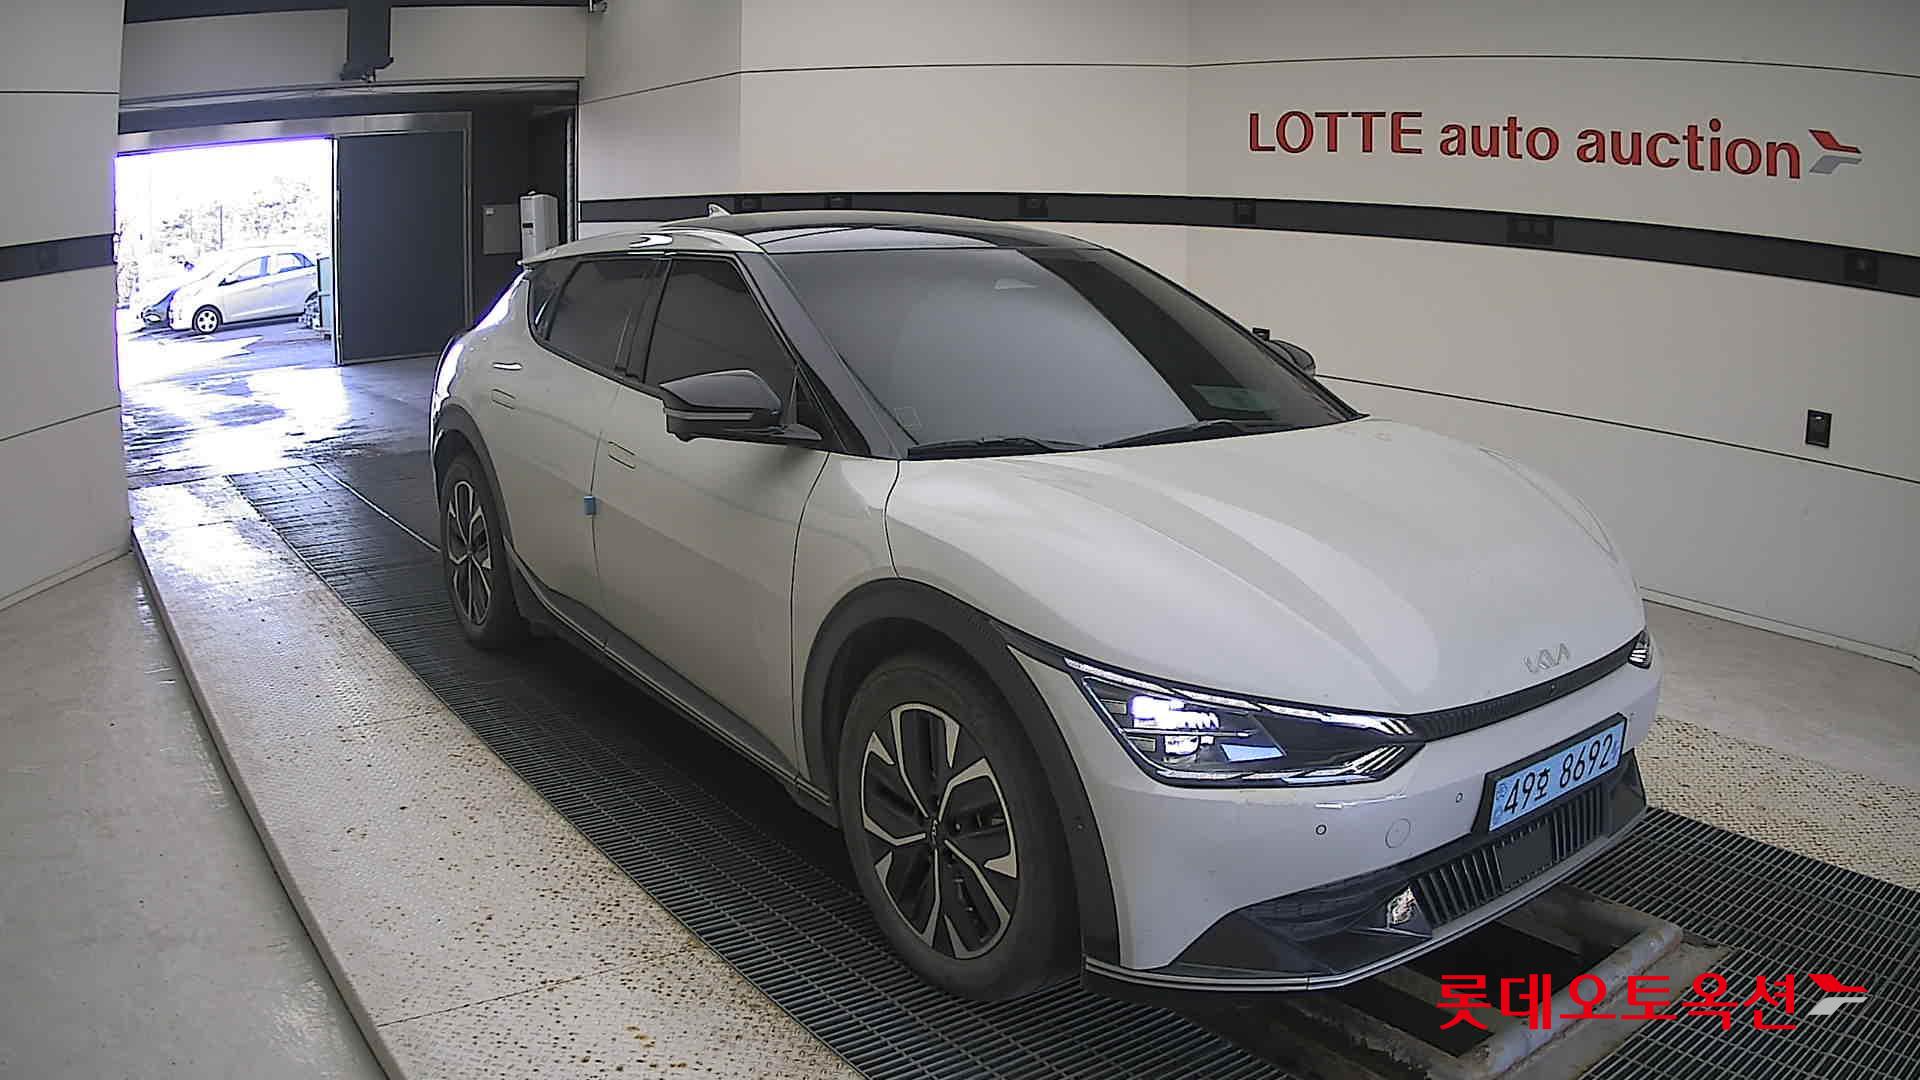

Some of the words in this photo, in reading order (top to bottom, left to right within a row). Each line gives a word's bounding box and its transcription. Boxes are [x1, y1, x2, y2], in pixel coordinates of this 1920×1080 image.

[1248, 111, 1424, 155] LOTTE
[1439, 116, 1560, 161] auto
[1576, 118, 1801, 179] auction
[1504, 767, 1551, 815] 49호
[1559, 733, 1613, 789] 8692
